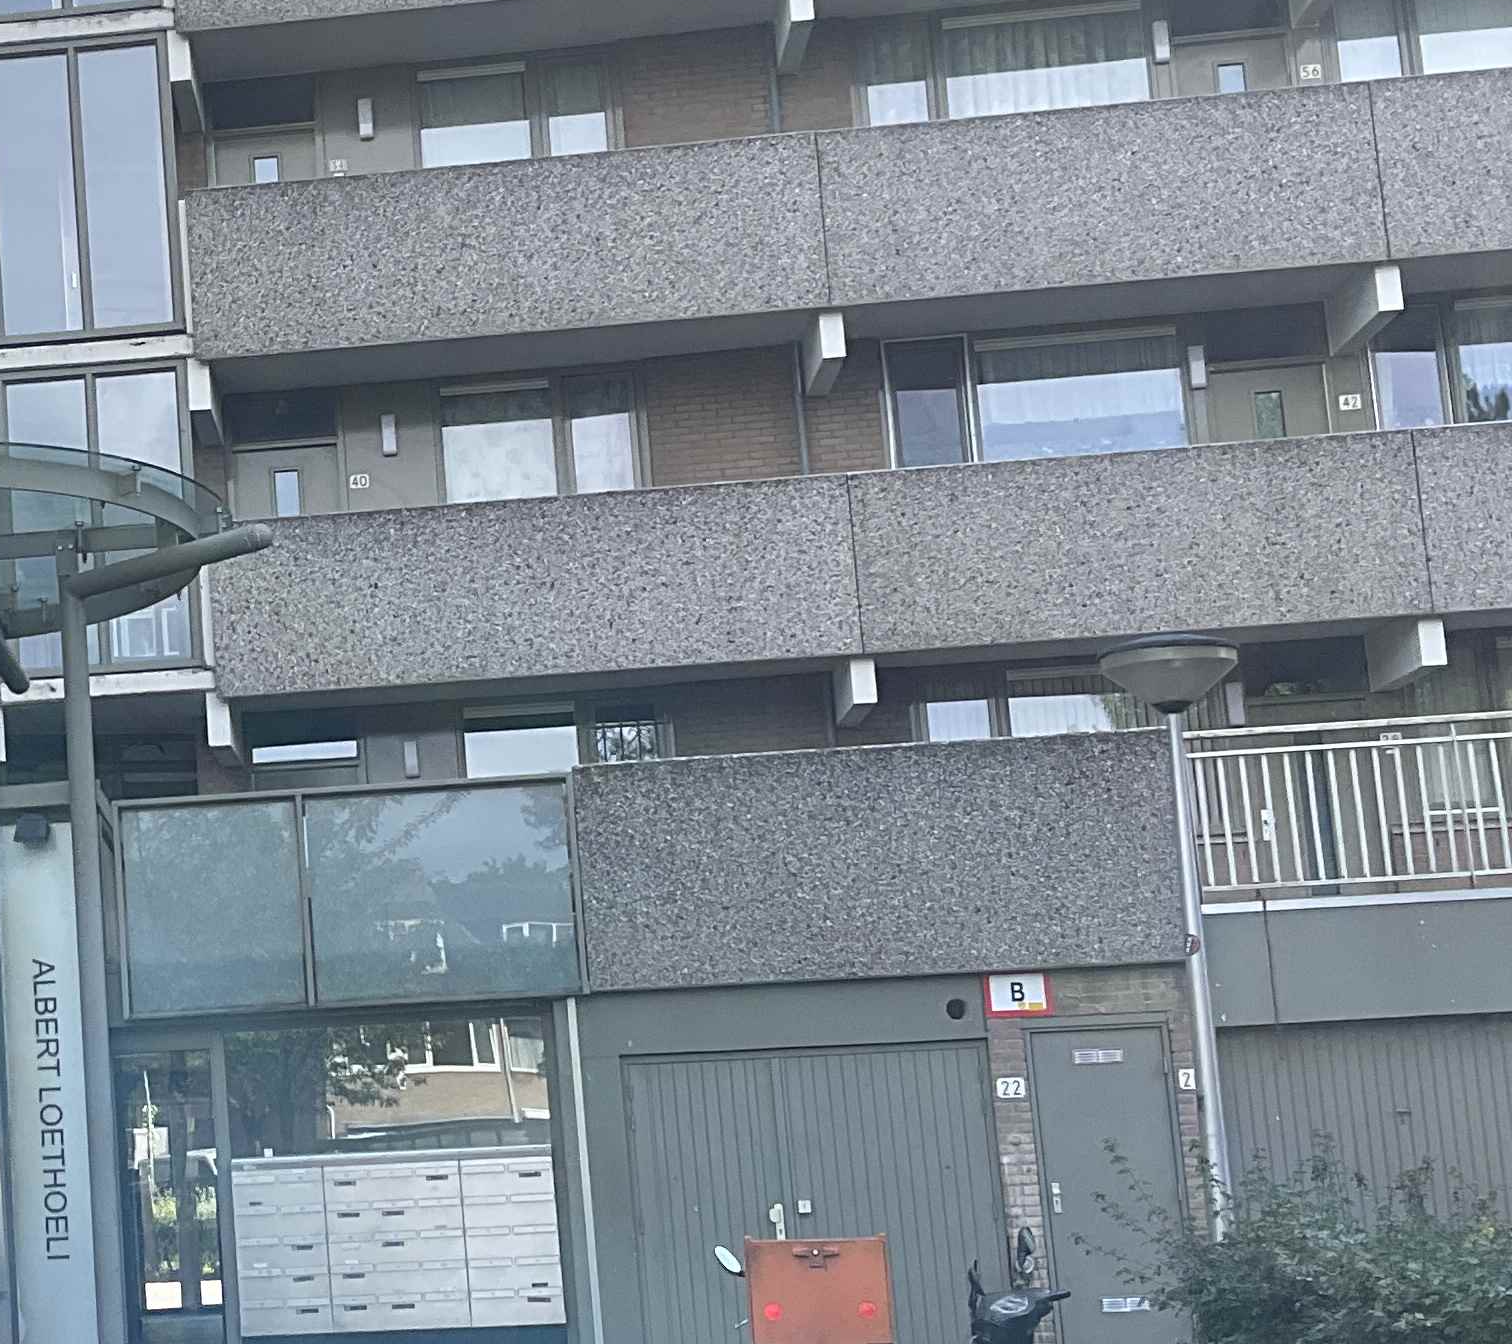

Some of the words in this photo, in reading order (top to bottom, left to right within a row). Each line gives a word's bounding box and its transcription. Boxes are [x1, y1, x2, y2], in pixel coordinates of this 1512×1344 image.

[1302, 65, 1320, 78] 56
[1342, 396, 1358, 408] 42
[352, 475, 368, 487] 40
[1010, 982, 1025, 1002] B
[32, 958, 61, 1077] ALBERT
[1000, 1080, 1022, 1096] 22
[1181, 1072, 1192, 1088] 2
[38, 1087, 71, 1260] LOETHOELI
